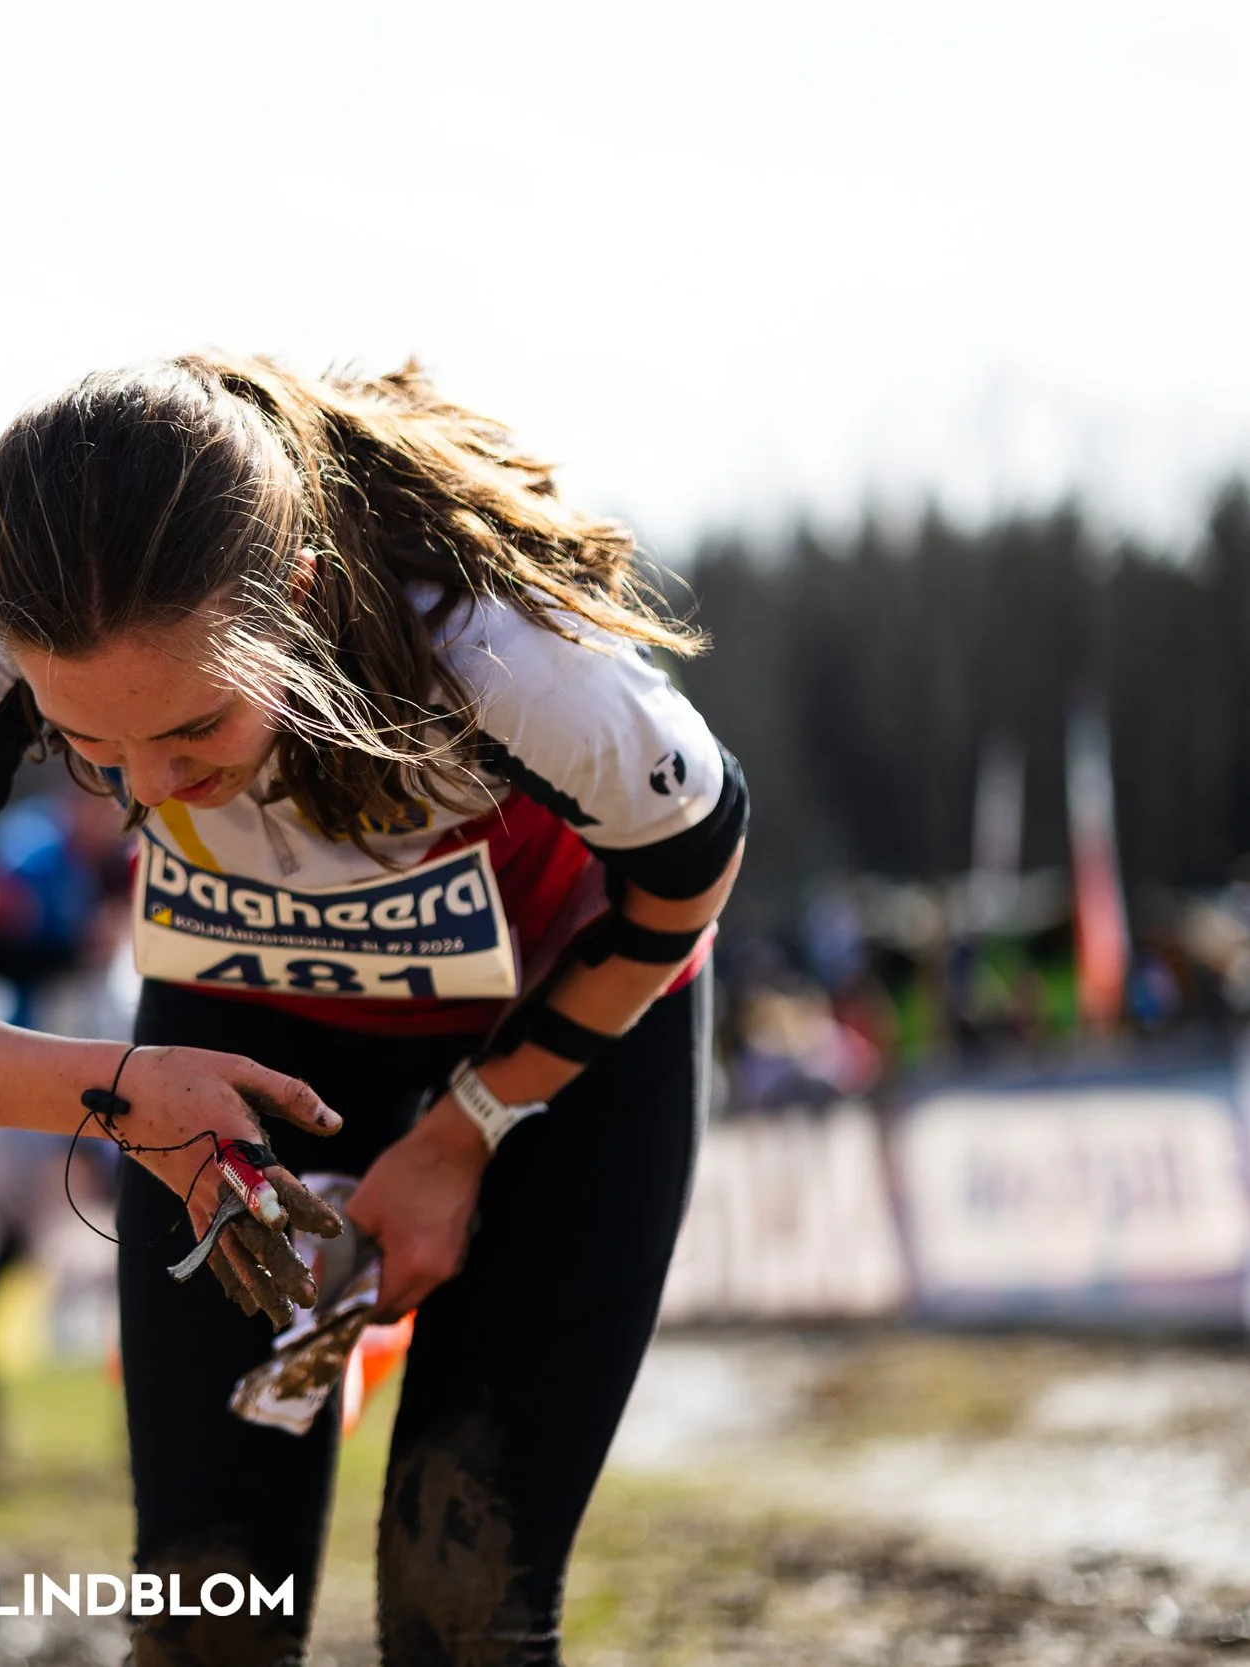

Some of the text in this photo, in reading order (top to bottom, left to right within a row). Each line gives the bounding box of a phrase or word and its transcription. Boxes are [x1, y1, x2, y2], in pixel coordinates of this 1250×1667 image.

[150, 844, 488, 931] bagheera
[418, 936, 465, 954] 2026
[196, 953, 438, 999] 481
